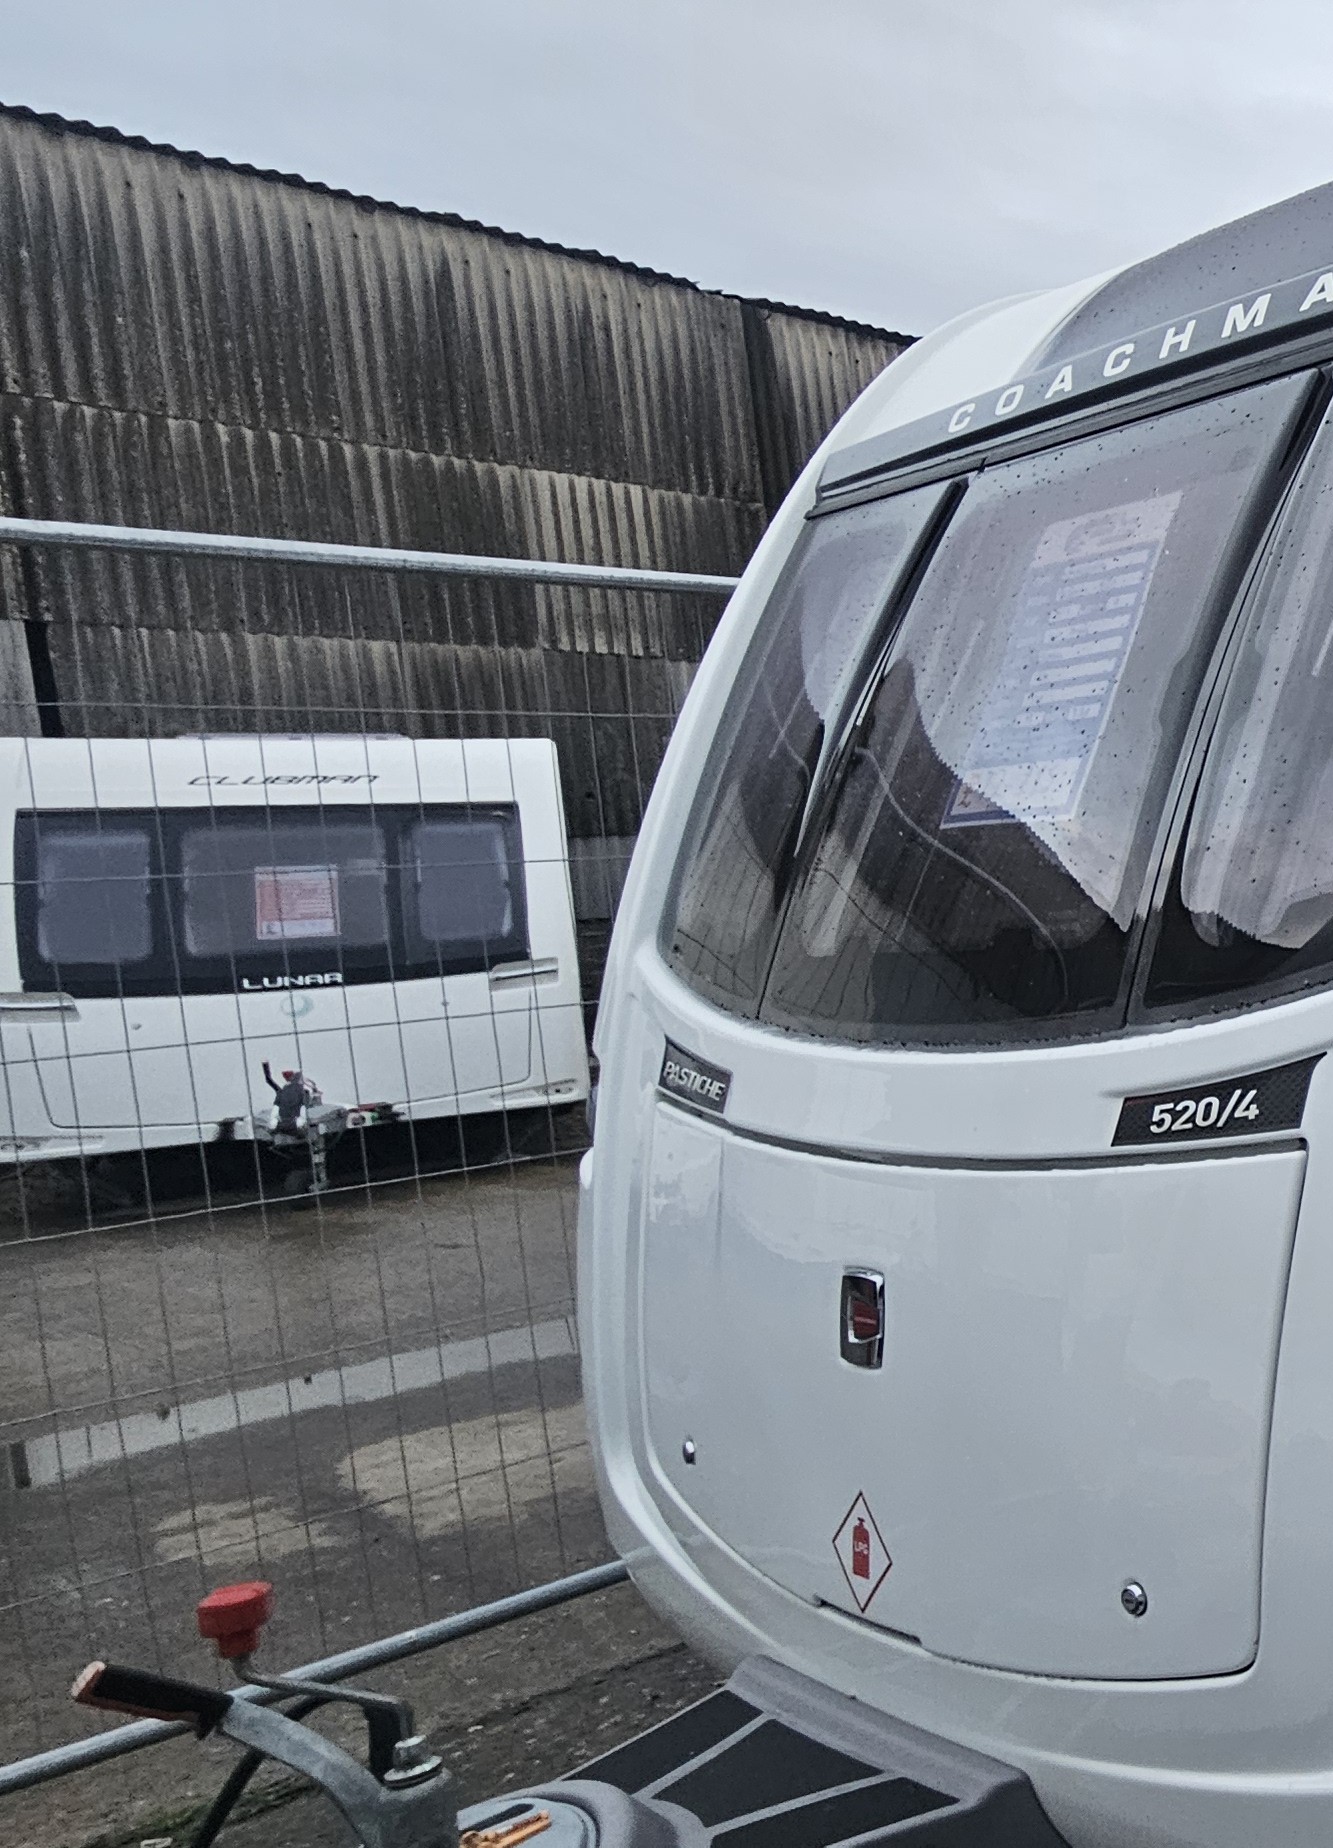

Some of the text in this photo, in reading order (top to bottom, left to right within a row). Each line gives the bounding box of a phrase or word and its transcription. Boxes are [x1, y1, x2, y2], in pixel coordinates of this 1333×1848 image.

[187, 775, 381, 785] CLUBMAN
[243, 971, 343, 990] LUNAR
[662, 1060, 726, 1101] PASTICHE
[1149, 1088, 1260, 1134] 520/4
